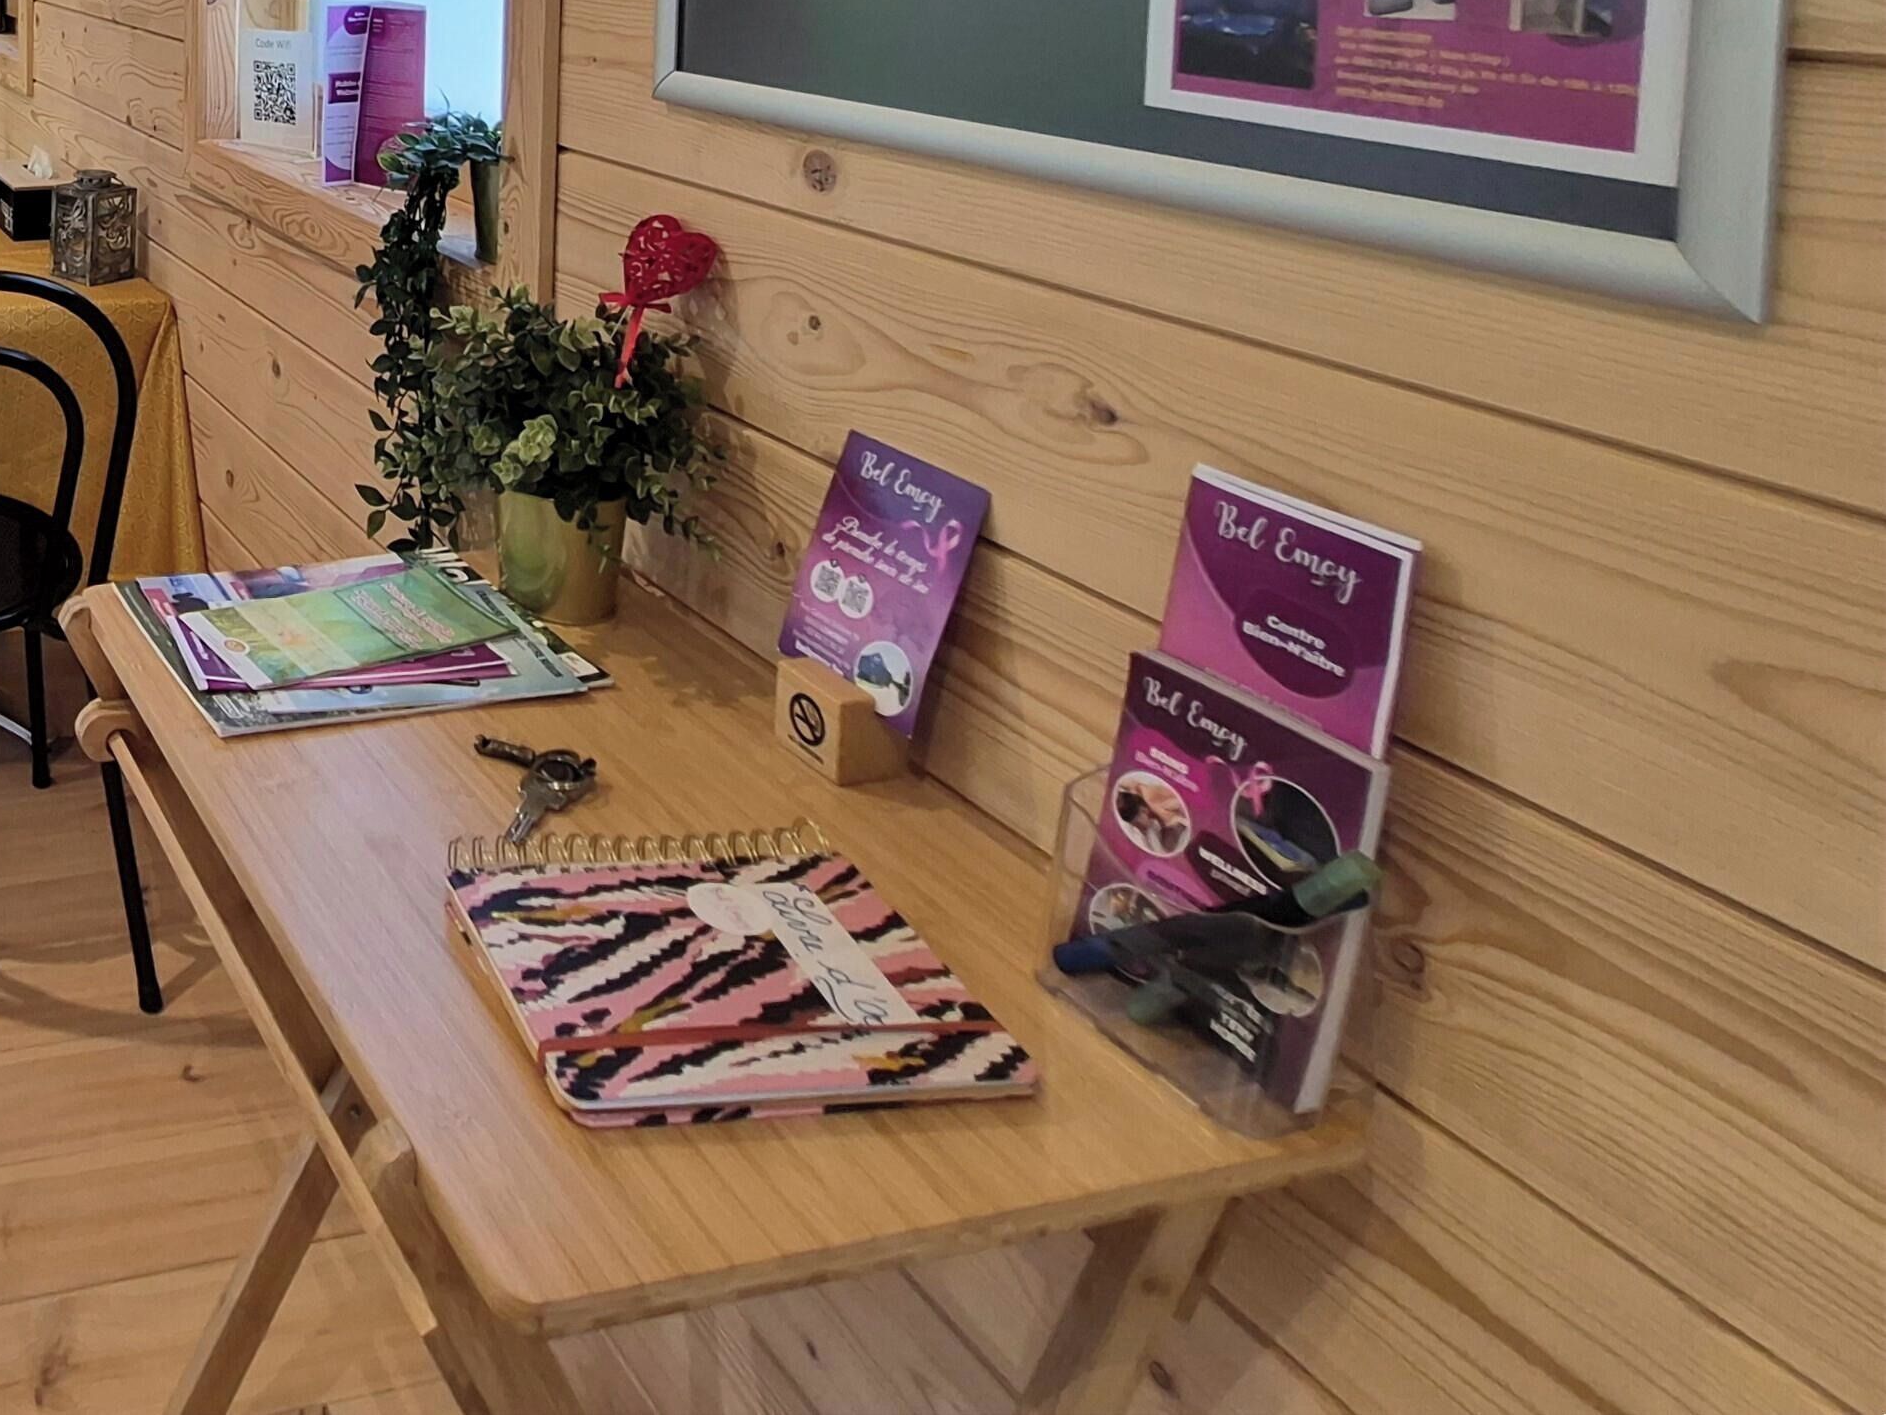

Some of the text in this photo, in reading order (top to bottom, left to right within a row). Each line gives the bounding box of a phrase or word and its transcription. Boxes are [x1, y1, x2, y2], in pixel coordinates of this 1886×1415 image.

[861, 450, 894, 487] Bel
[1214, 500, 1269, 551] Bel
[1266, 614, 1327, 651] Centre
[1142, 675, 1181, 718] Bel
